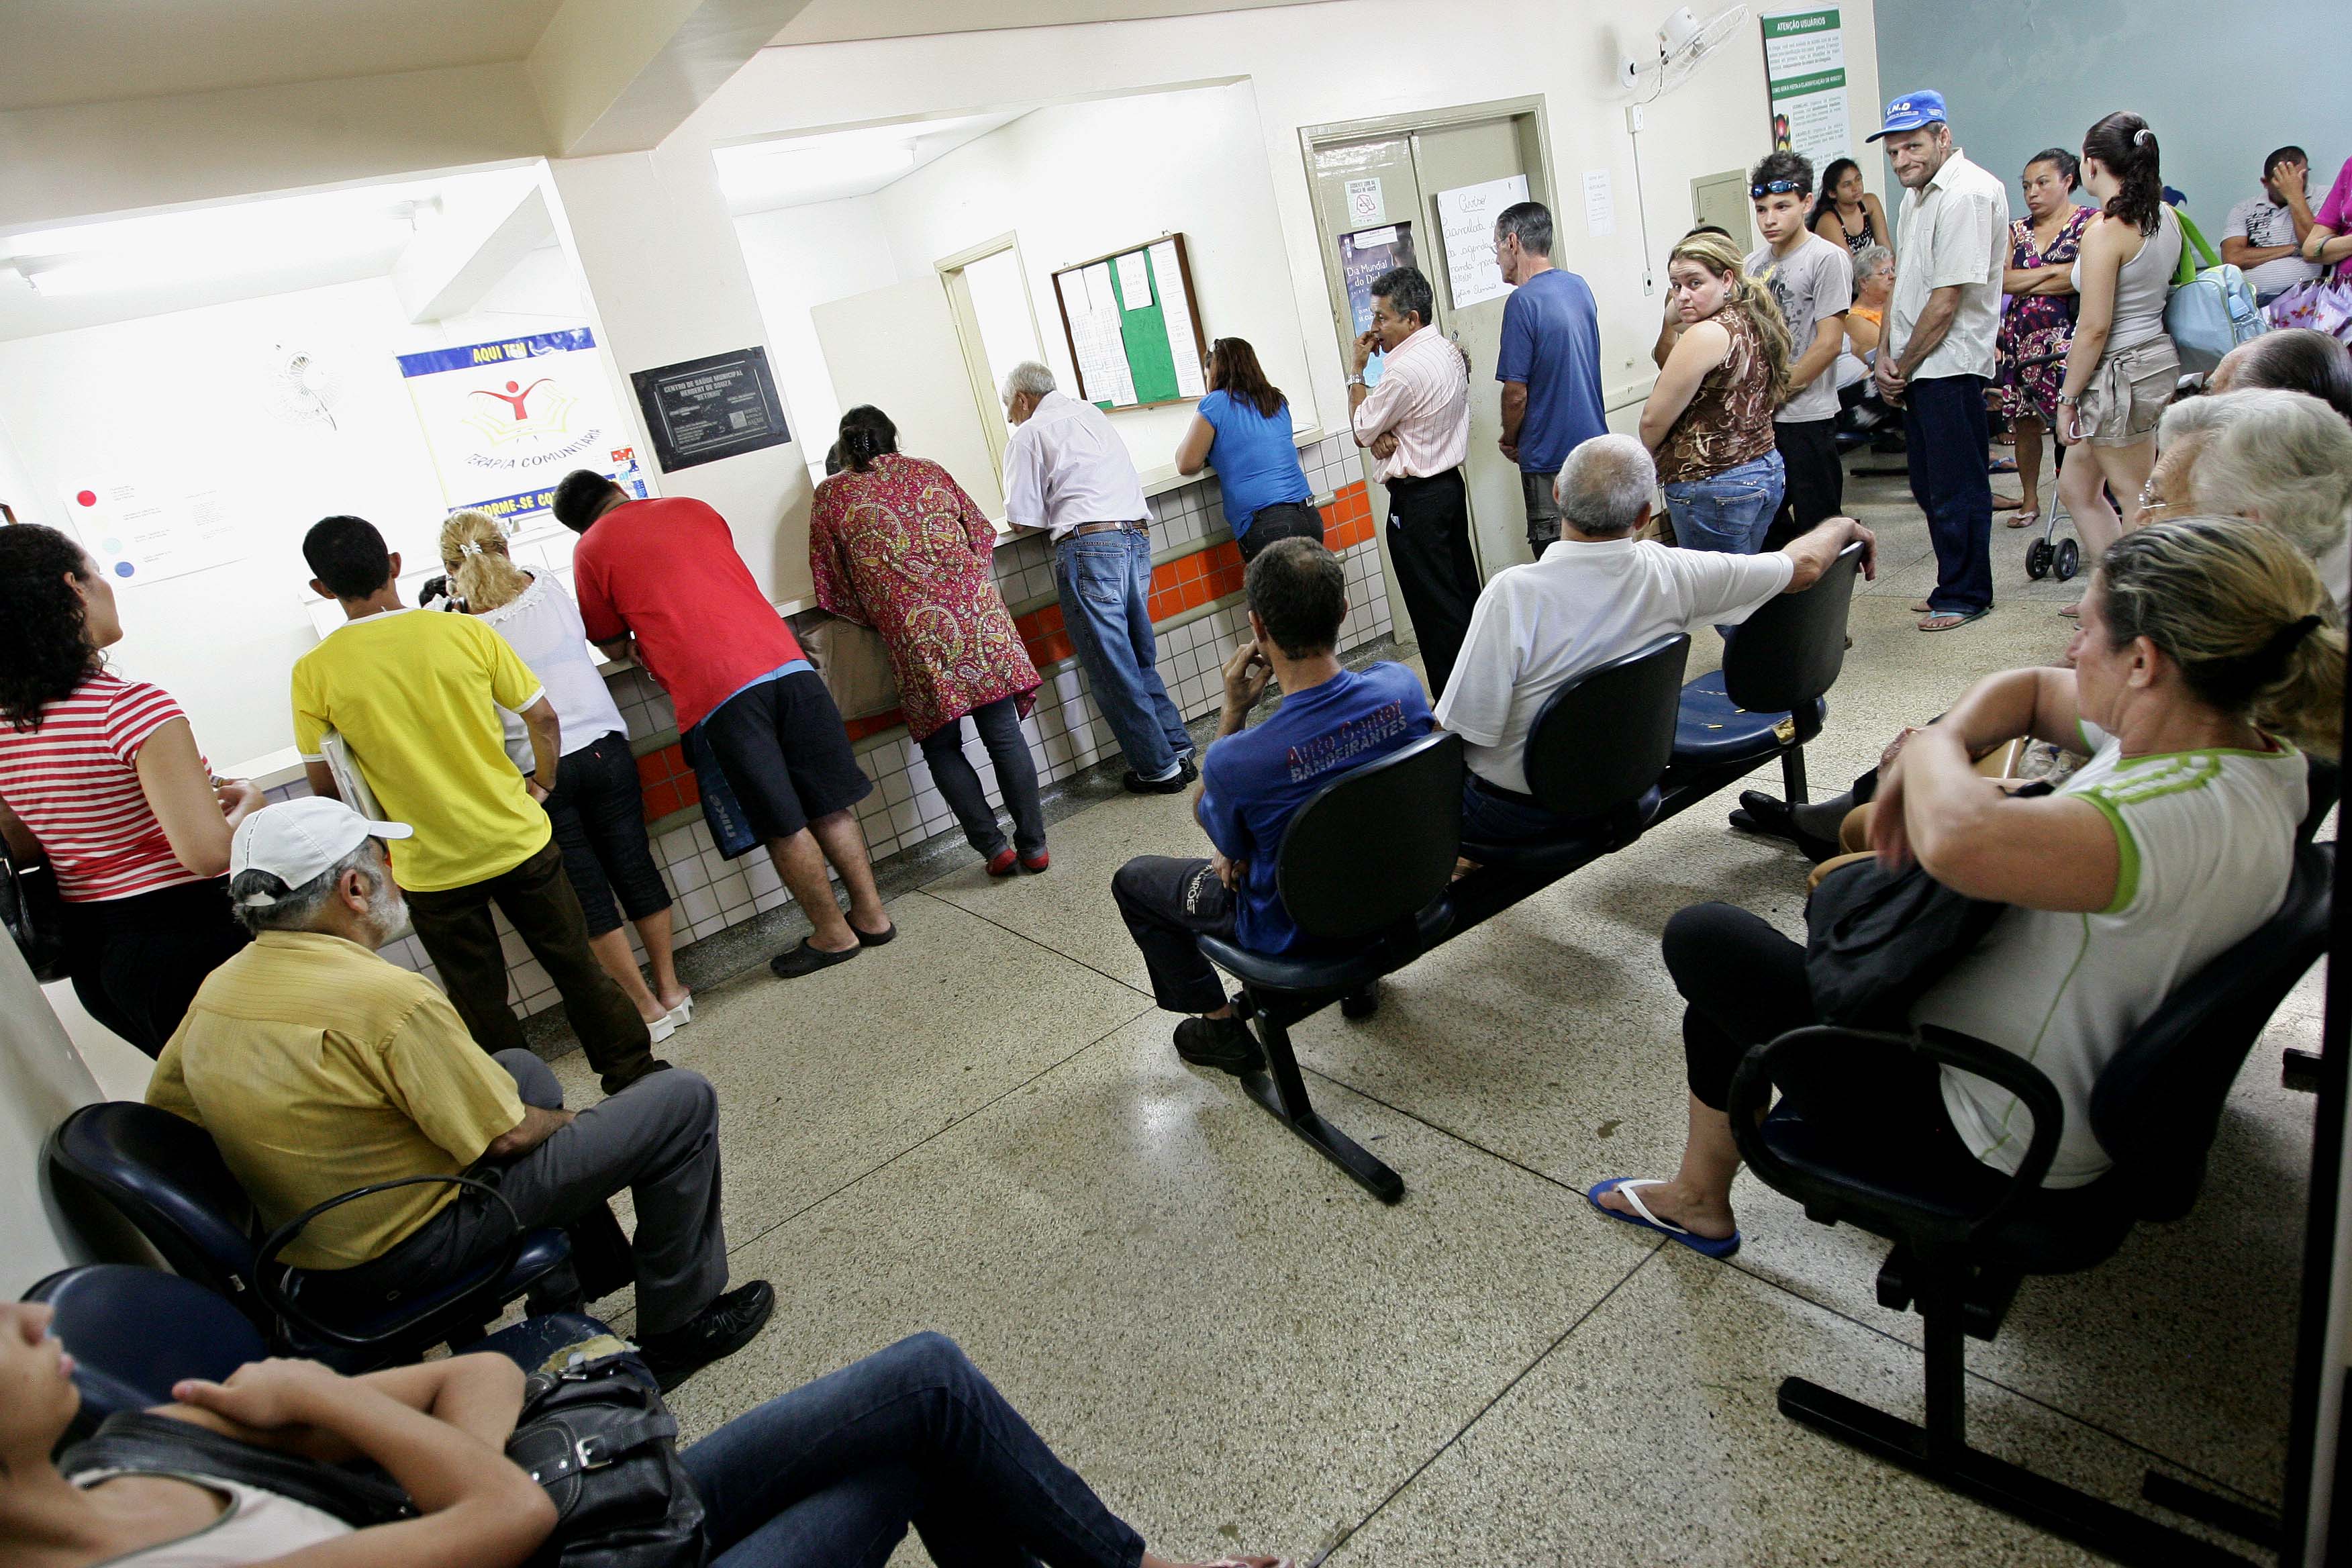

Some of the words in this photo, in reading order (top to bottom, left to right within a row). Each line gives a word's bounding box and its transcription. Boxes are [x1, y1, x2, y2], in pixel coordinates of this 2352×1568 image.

[1777, 19, 1800, 32] ATENÇÃO
[1800, 16, 1826, 28] USUÁRIOS
[1347, 267, 1360, 277] Dia
[1361, 260, 1387, 273] Mundial
[1355, 277, 1365, 287] do
[473, 346, 503, 364] AQUI
[663, 383, 686, 393] CENTRO
[695, 376, 714, 386] SAÚDE
[714, 370, 743, 382] MUNICIPAL
[713, 380, 732, 389] SOUZA
[467, 454, 515, 469] TERAPIA
[521, 428, 602, 469] COMUNITÁRIA
[474, 493, 534, 516] FORME-SE
[538, 490, 556, 506] CO
[1290, 715, 1408, 783] BANDEIRANTES
